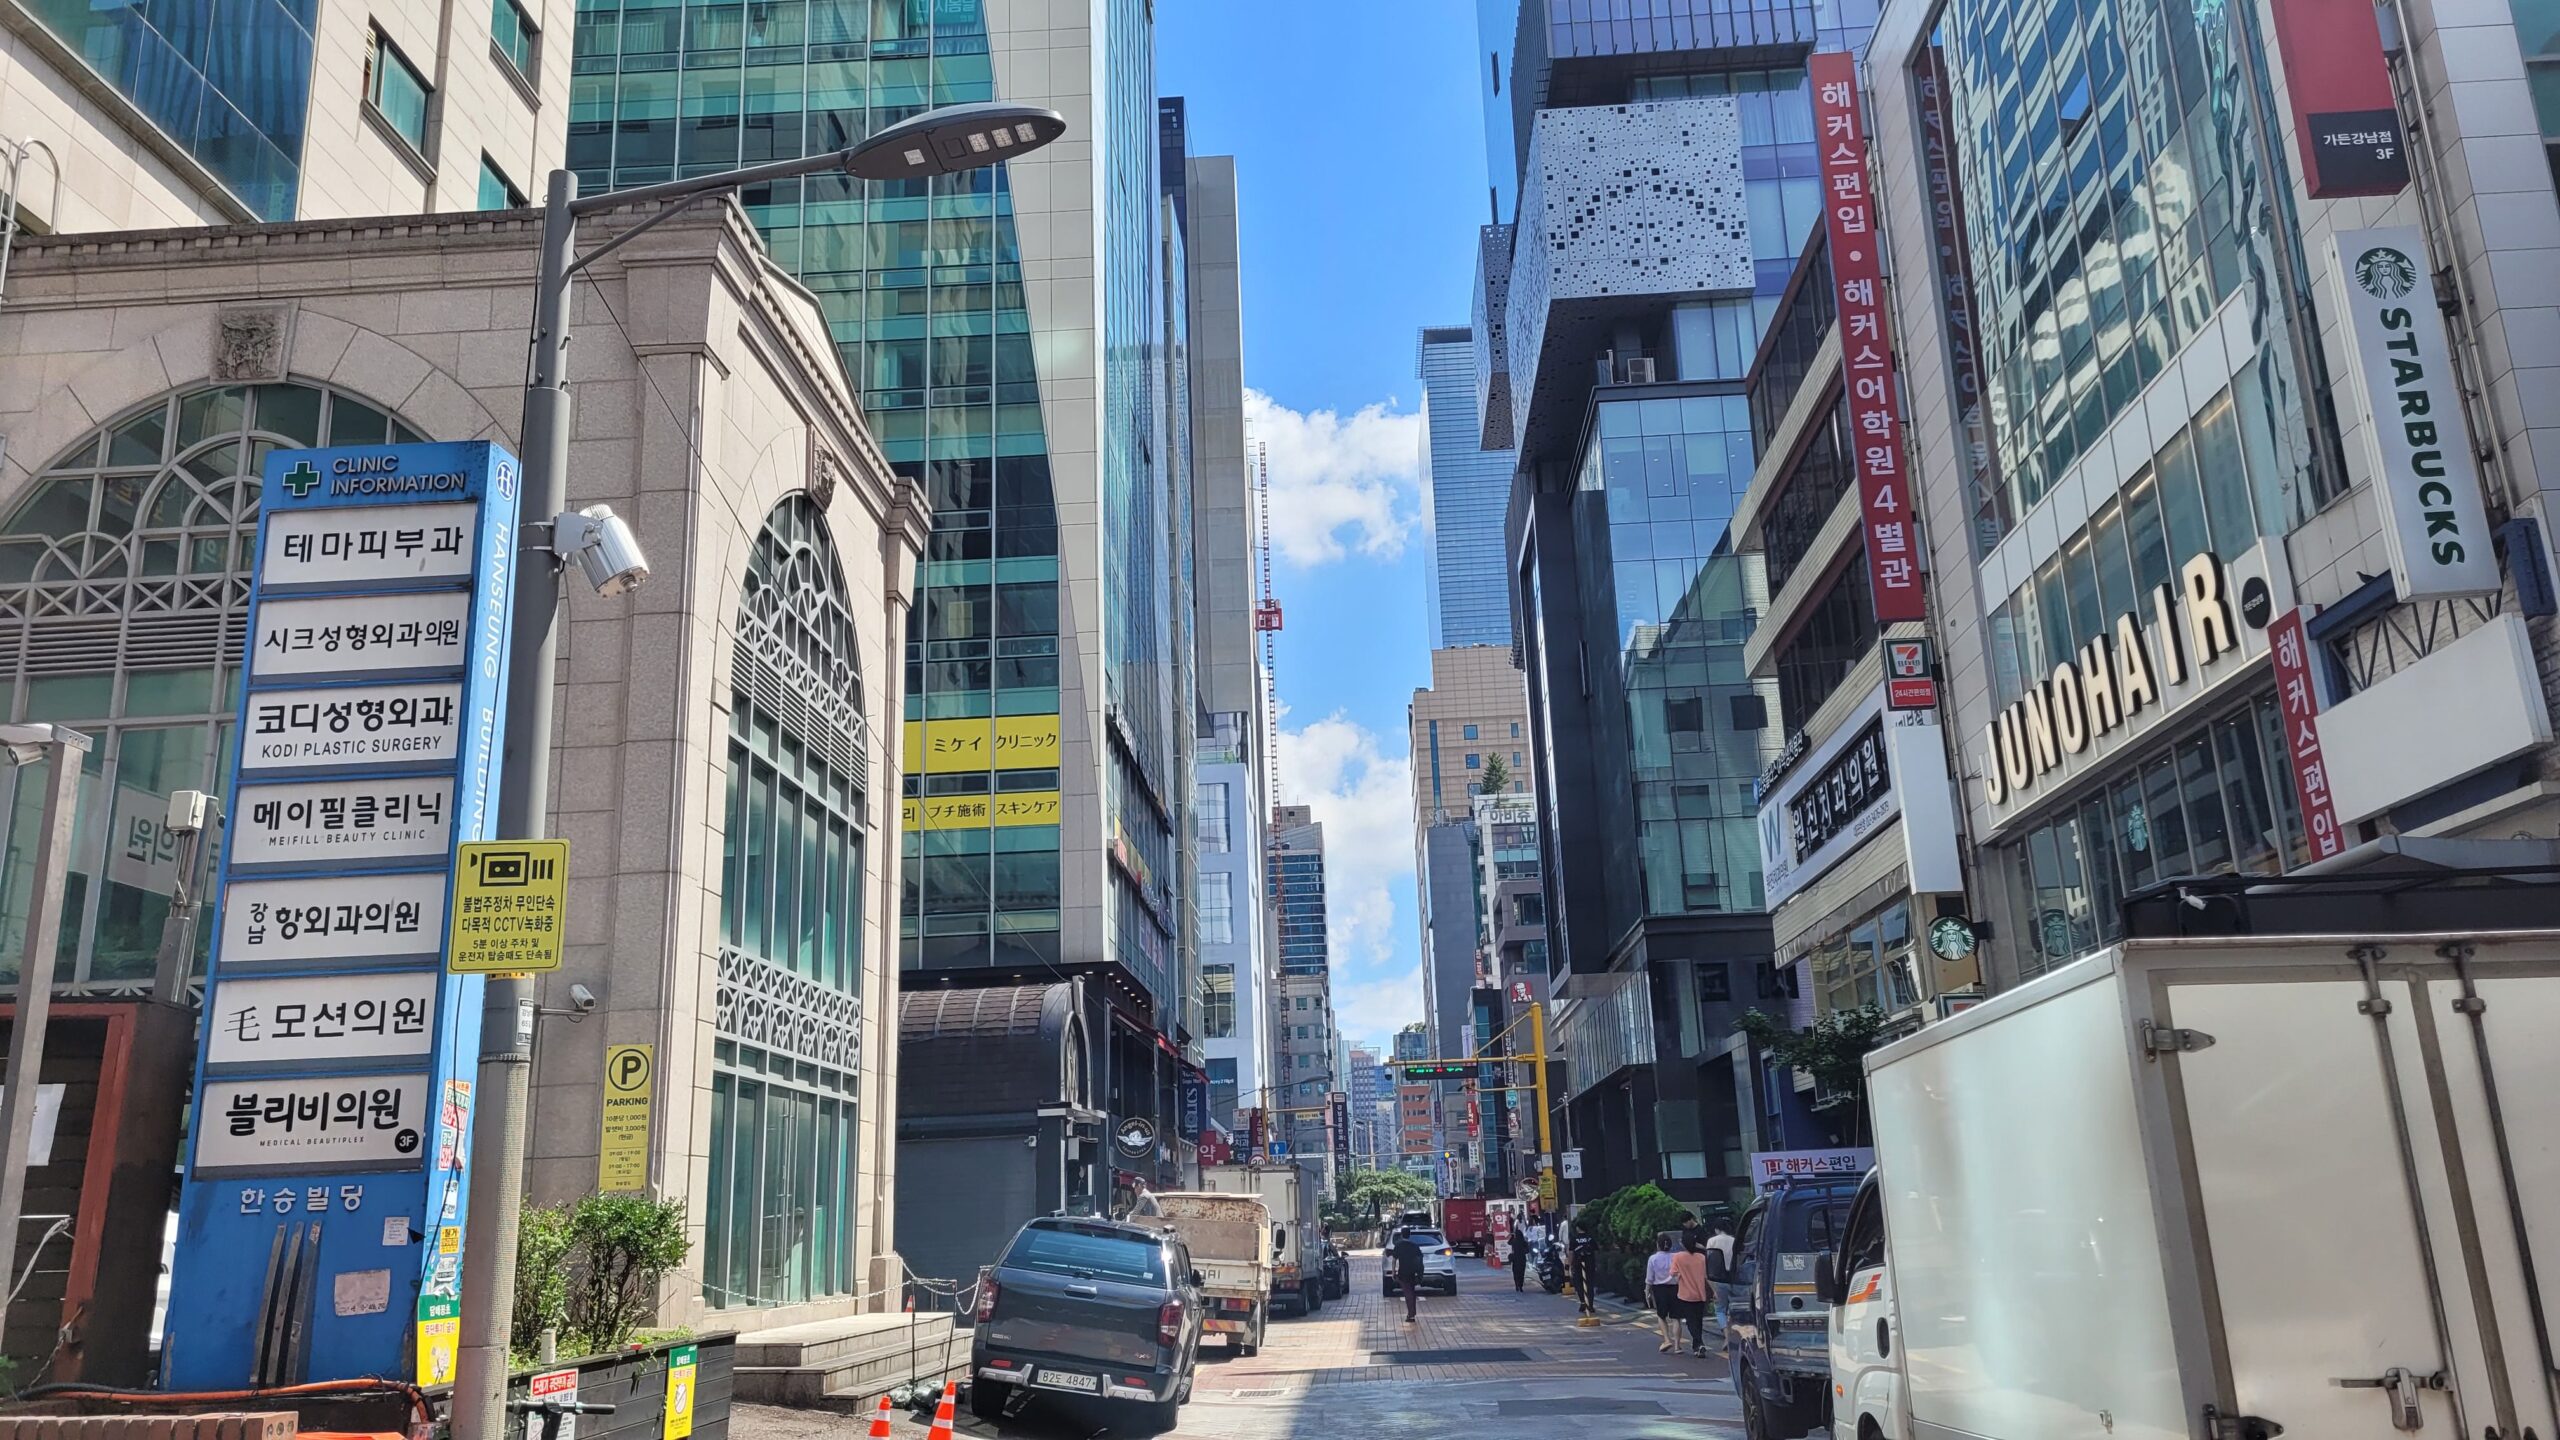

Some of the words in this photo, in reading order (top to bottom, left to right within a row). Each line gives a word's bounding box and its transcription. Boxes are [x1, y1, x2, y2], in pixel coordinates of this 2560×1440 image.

[2322, 131, 2393, 147] 가든강남점
[1821, 80, 1868, 235] 해커스편입
[2376, 146, 2395, 161] 3F
[2380, 306, 2466, 567] STARBUCKS
[333, 456, 398, 474] CLINIC
[330, 473, 464, 495] INFORMATION
[284, 526, 464, 562] 테마피부과
[484, 522, 508, 680] HANSEUNG
[264, 620, 460, 654] 시크성형외과의원
[1985, 552, 2237, 806] JUNOHAIR
[256, 697, 453, 734] 코디성형외과
[262, 744, 298, 758] KODI
[303, 740, 365, 756] PLASTIC
[372, 736, 442, 753] SURGERY
[934, 736, 982, 752] ミケイ
[996, 733, 1057, 750] クリニック
[2276, 625, 2339, 858] 해커스편입
[471, 707, 494, 841] BUILDING
[1792, 735, 1880, 852] 원진치과의원
[253, 792, 441, 830] 메이필클리닉
[996, 800, 1057, 816] スキンケア
[269, 835, 319, 846] MEIFILL
[326, 832, 376, 843] BEAUTY
[383, 829, 426, 840] CLINIC
[463, 896, 513, 913] 불법주정차
[515, 894, 556, 912] 무인단속
[275, 902, 421, 940] 항외과의원
[462, 916, 491, 934] 다목적
[493, 915, 553, 932] CCTV녹화중
[473, 939, 487, 949] 5분
[490, 938, 508, 949] 이상
[511, 938, 528, 948] 주차
[531, 937, 539, 948] 및
[458, 951, 485, 962] 운전자
[488, 950, 523, 961] 탑승때도
[526, 949, 552, 960] 단속됨
[224, 1006, 261, 1042] 毛
[272, 998, 427, 1039] 모션의원
[621, 1055, 642, 1085] P
[606, 1097, 648, 1107] PARKING
[226, 1089, 402, 1137] 블리비의원
[1120, 1121, 1152, 1136] Angel-in-us
[260, 1138, 301, 1147] MEDICAL
[307, 1136, 364, 1145] BEAUTIPLEX
[399, 1135, 415, 1147] 3F
[1200, 1144, 1217, 1161] 약
[1786, 1156, 1856, 1173] 해커스편입
[240, 1184, 365, 1214] 한승빌딩
[1495, 1215, 1507, 1227] 약
[1042, 1372, 1063, 1384] 82도
[1066, 1374, 1092, 1388] 4847
